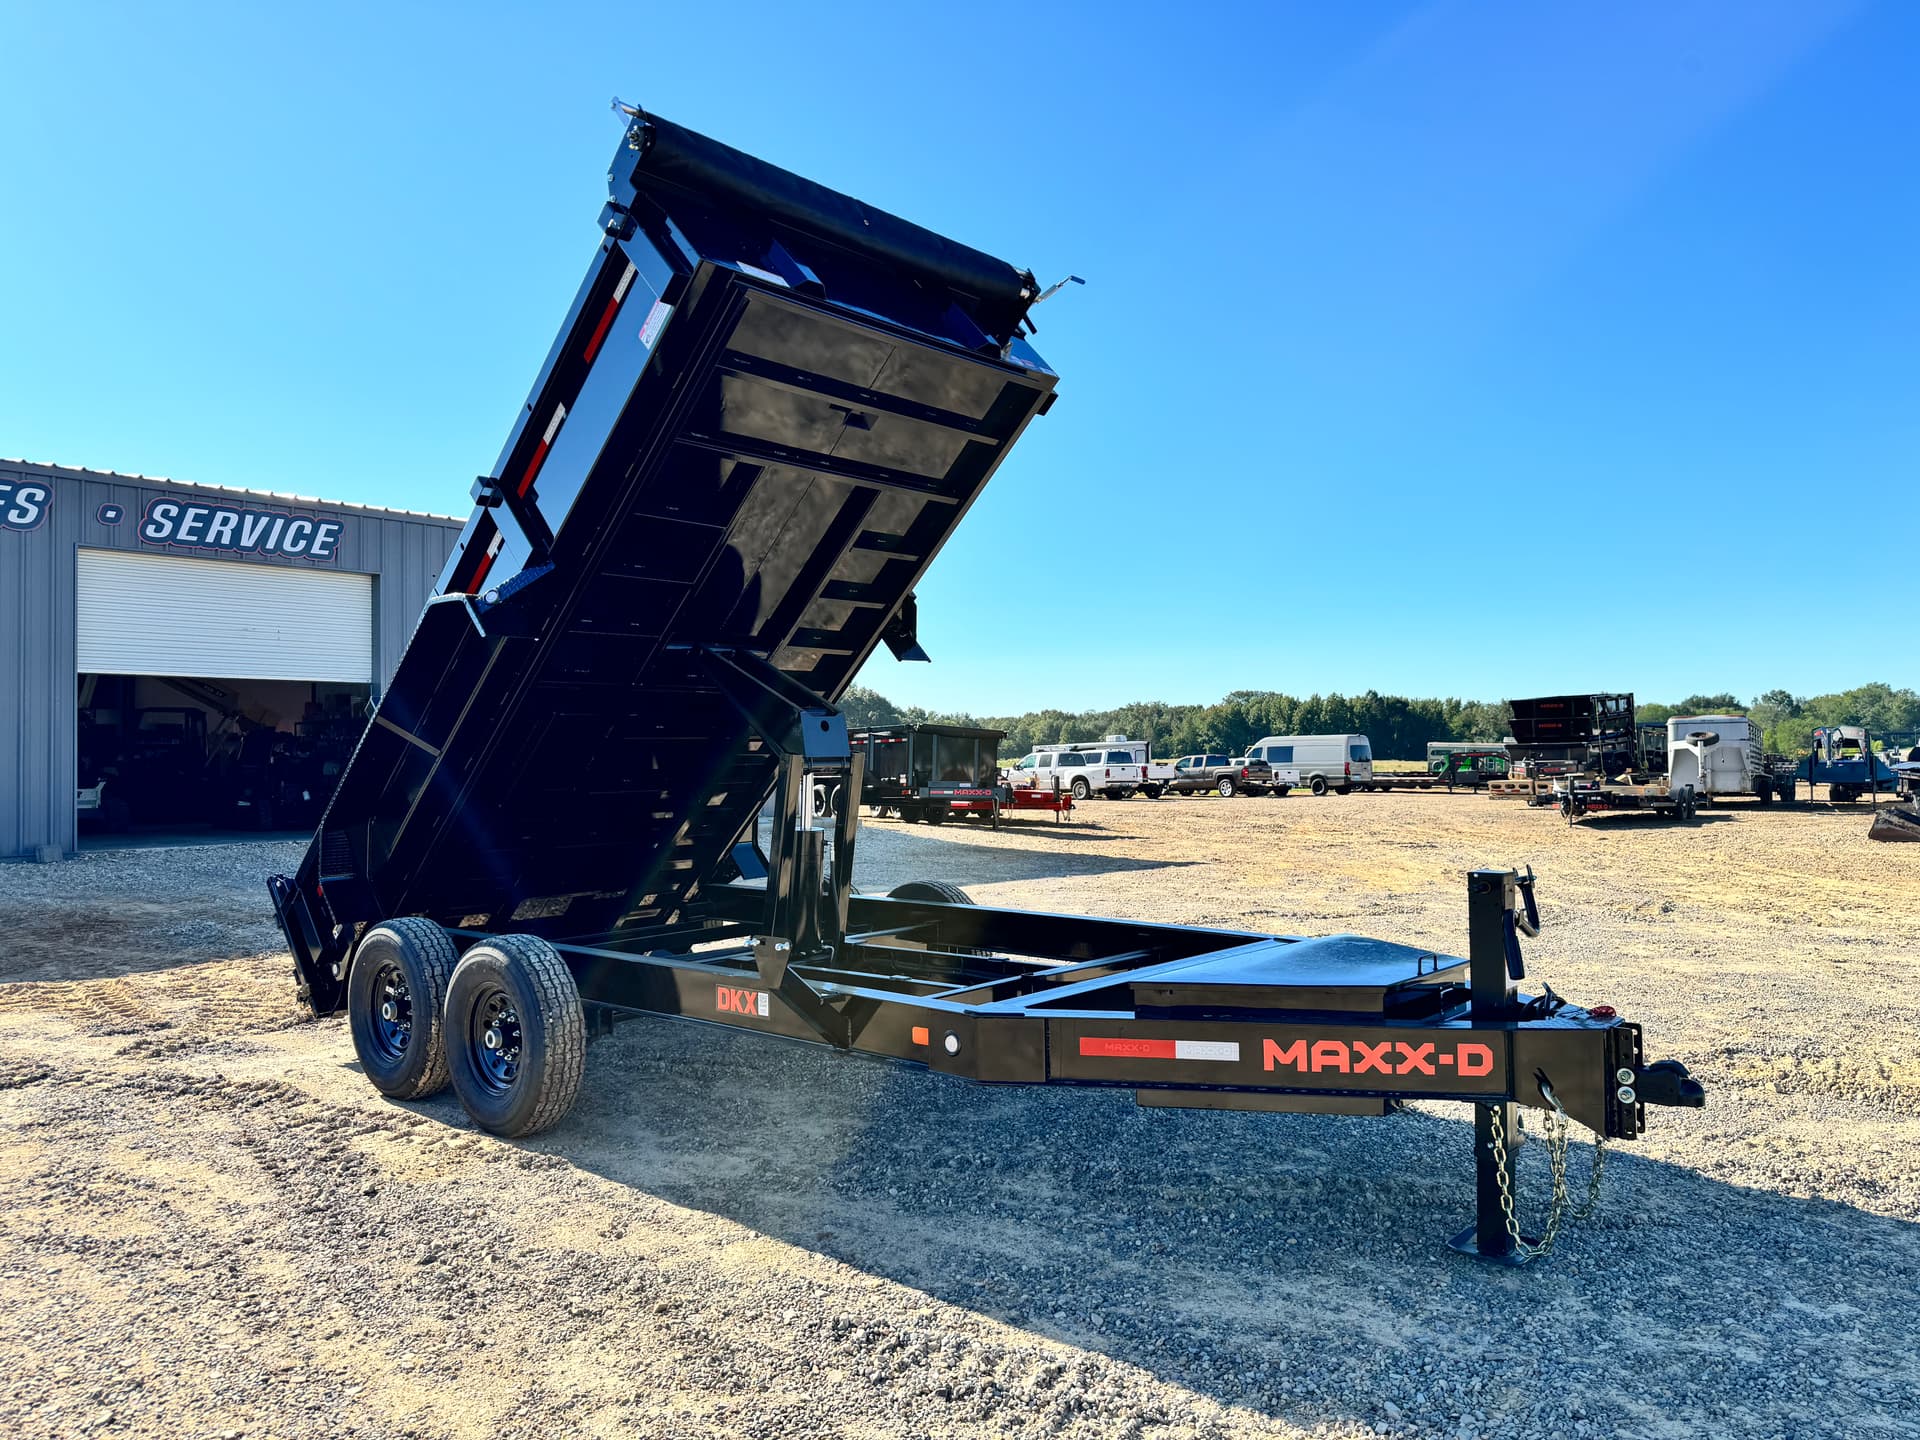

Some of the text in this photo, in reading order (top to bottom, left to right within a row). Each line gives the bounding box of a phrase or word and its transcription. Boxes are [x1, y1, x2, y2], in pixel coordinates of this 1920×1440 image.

[145, 503, 340, 556] SERVICE
[717, 986, 758, 1017] DKX
[1262, 1038, 1494, 1077] MAXX-D
